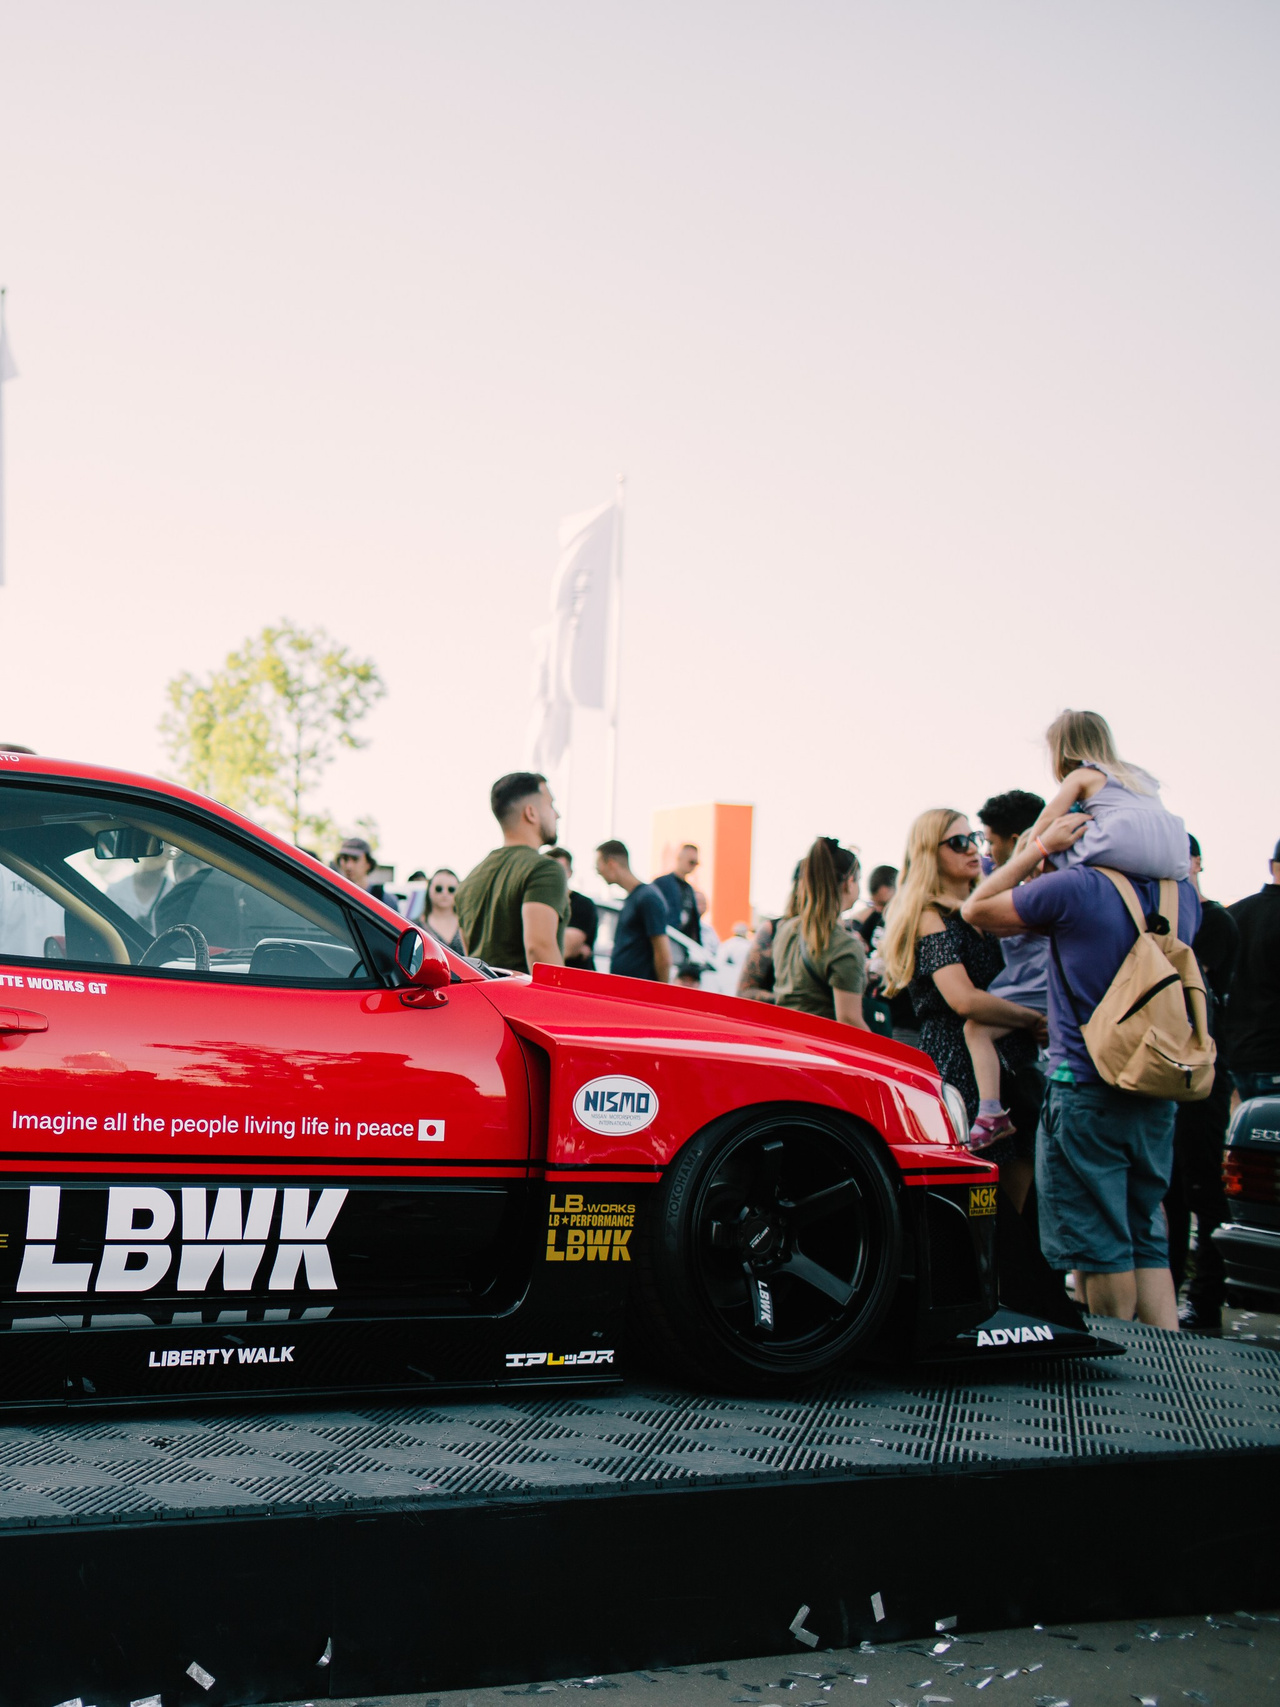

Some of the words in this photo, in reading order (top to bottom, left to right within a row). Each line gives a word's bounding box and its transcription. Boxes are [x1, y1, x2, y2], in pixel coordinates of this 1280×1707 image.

[27, 975, 86, 993] WORKS
[88, 981, 108, 995] GT
[584, 1090, 650, 1113] NISMO
[12, 1110, 98, 1136] Imagine
[103, 1112, 127, 1133] all
[132, 1112, 165, 1134] the
[171, 1114, 240, 1139] people
[244, 1115, 296, 1140] living
[301, 1115, 329, 1137] life
[335, 1117, 352, 1137] in
[356, 1121, 415, 1141] peace
[667, 1149, 700, 1219] YOKOHAMA
[970, 1187, 997, 1208] NGK
[15, 1185, 350, 1293] LBWK
[545, 1229, 632, 1261] LBWK
[757, 1279, 772, 1324] LBWK
[976, 1324, 1054, 1347] ADVAN
[148, 1347, 235, 1368] LIBERTY
[238, 1345, 296, 1364] WALK
[505, 1349, 615, 1367] エアレックス
